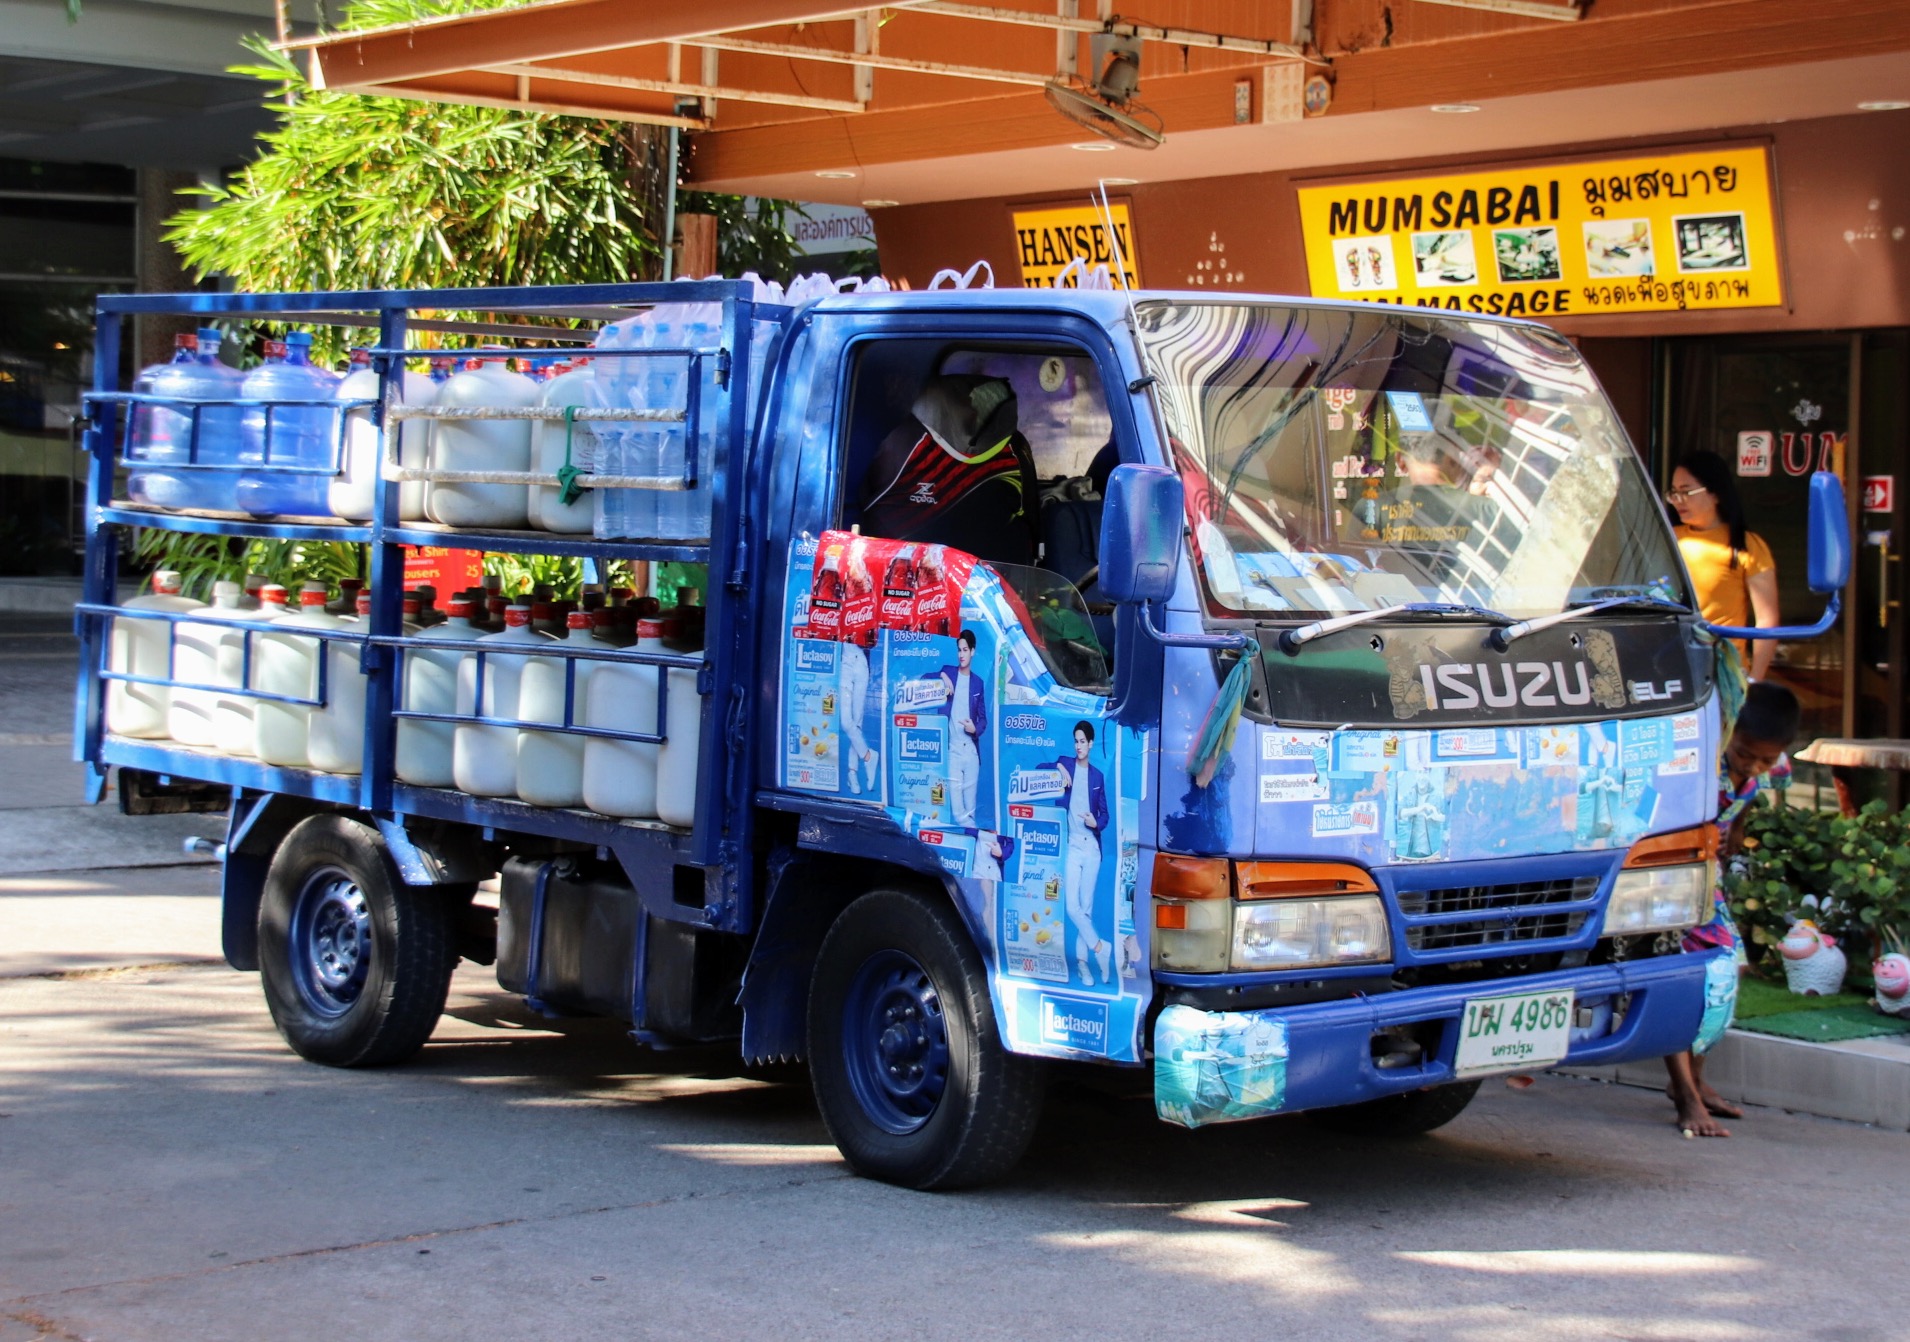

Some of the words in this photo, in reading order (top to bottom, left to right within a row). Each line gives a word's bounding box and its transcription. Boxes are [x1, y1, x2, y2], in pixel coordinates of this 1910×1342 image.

[1583, 165, 1737, 218] มุมสบาย
[1018, 223, 1128, 267] HANSEN
[1583, 274, 1749, 310] นวดเพื่อสุขภาพ
[424, 546, 448, 557] Shirt
[466, 565, 479, 577] 25
[797, 643, 833, 668] Lactasoy
[793, 683, 821, 699] Original
[1420, 661, 1590, 710] ISUZU
[1633, 679, 1682, 700] ELF
[1005, 713, 1046, 730] ออริจินัล
[901, 732, 940, 758] Lactasoy
[1036, 738, 1043, 747] 9
[899, 774, 930, 789] Original
[1009, 765, 1029, 794] ดื่ม
[1017, 823, 1059, 851] Lactasoy
[1044, 1002, 1104, 1041] Lactasoy
[1510, 996, 1569, 1033] 4986
[1492, 1040, 1534, 1059] นครปฐม
